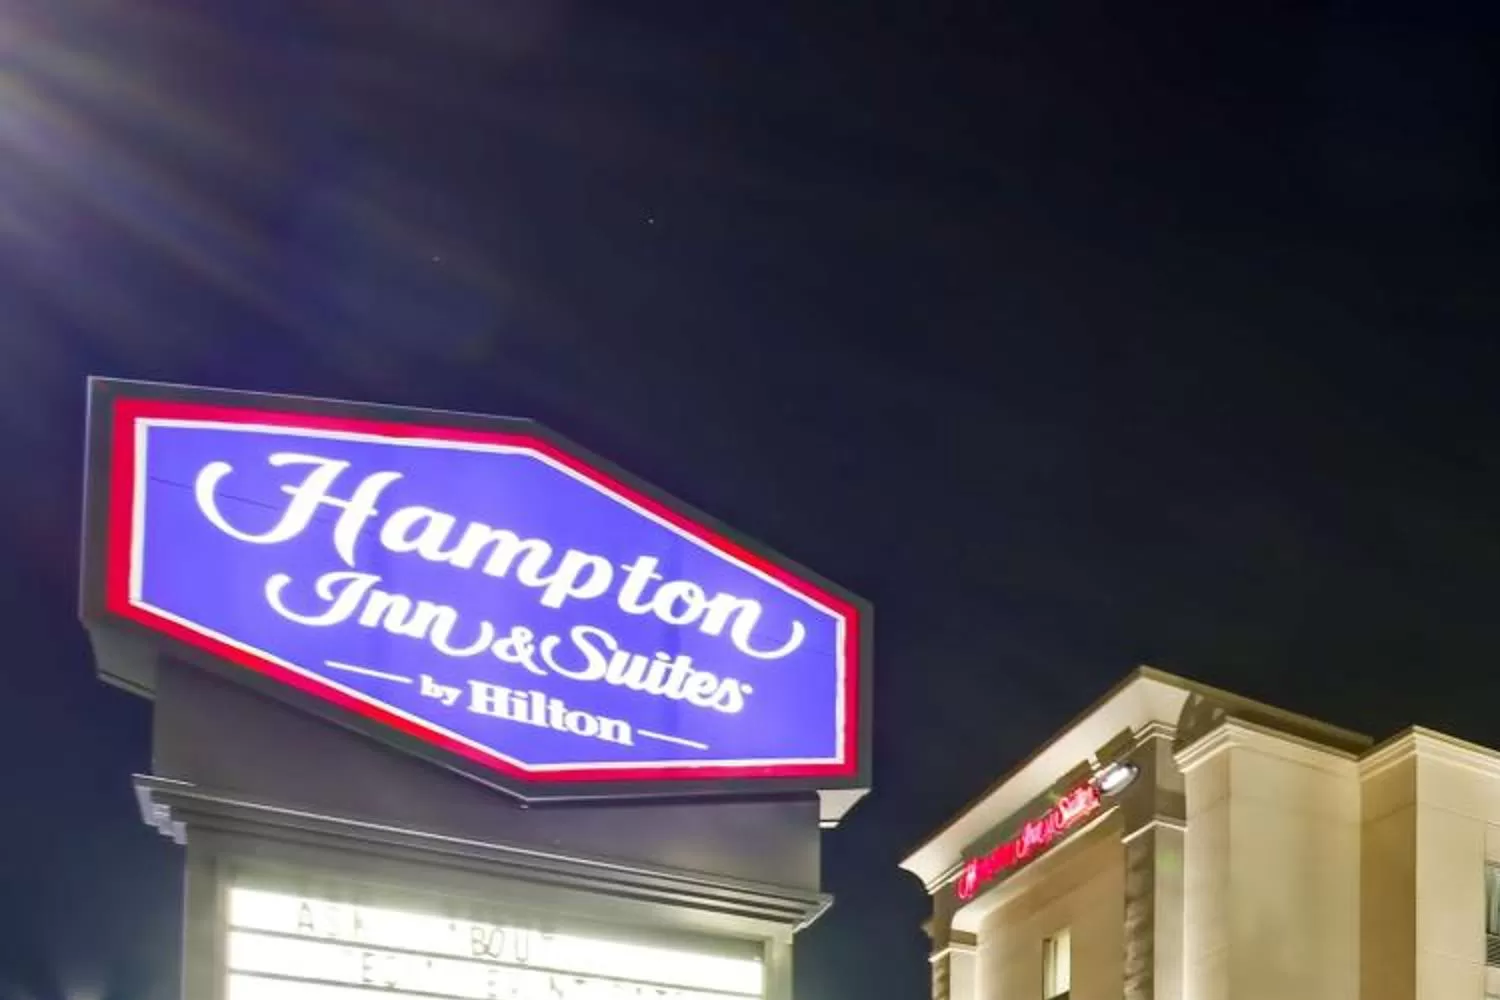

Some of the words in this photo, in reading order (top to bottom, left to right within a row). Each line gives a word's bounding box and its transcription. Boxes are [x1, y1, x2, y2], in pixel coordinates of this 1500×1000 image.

[195, 452, 806, 660] Hampton
[264, 571, 495, 657] Inn
[490, 625, 548, 676] &
[539, 625, 753, 714] Suites
[420, 674, 462, 707] by
[467, 679, 633, 746] Hilton
